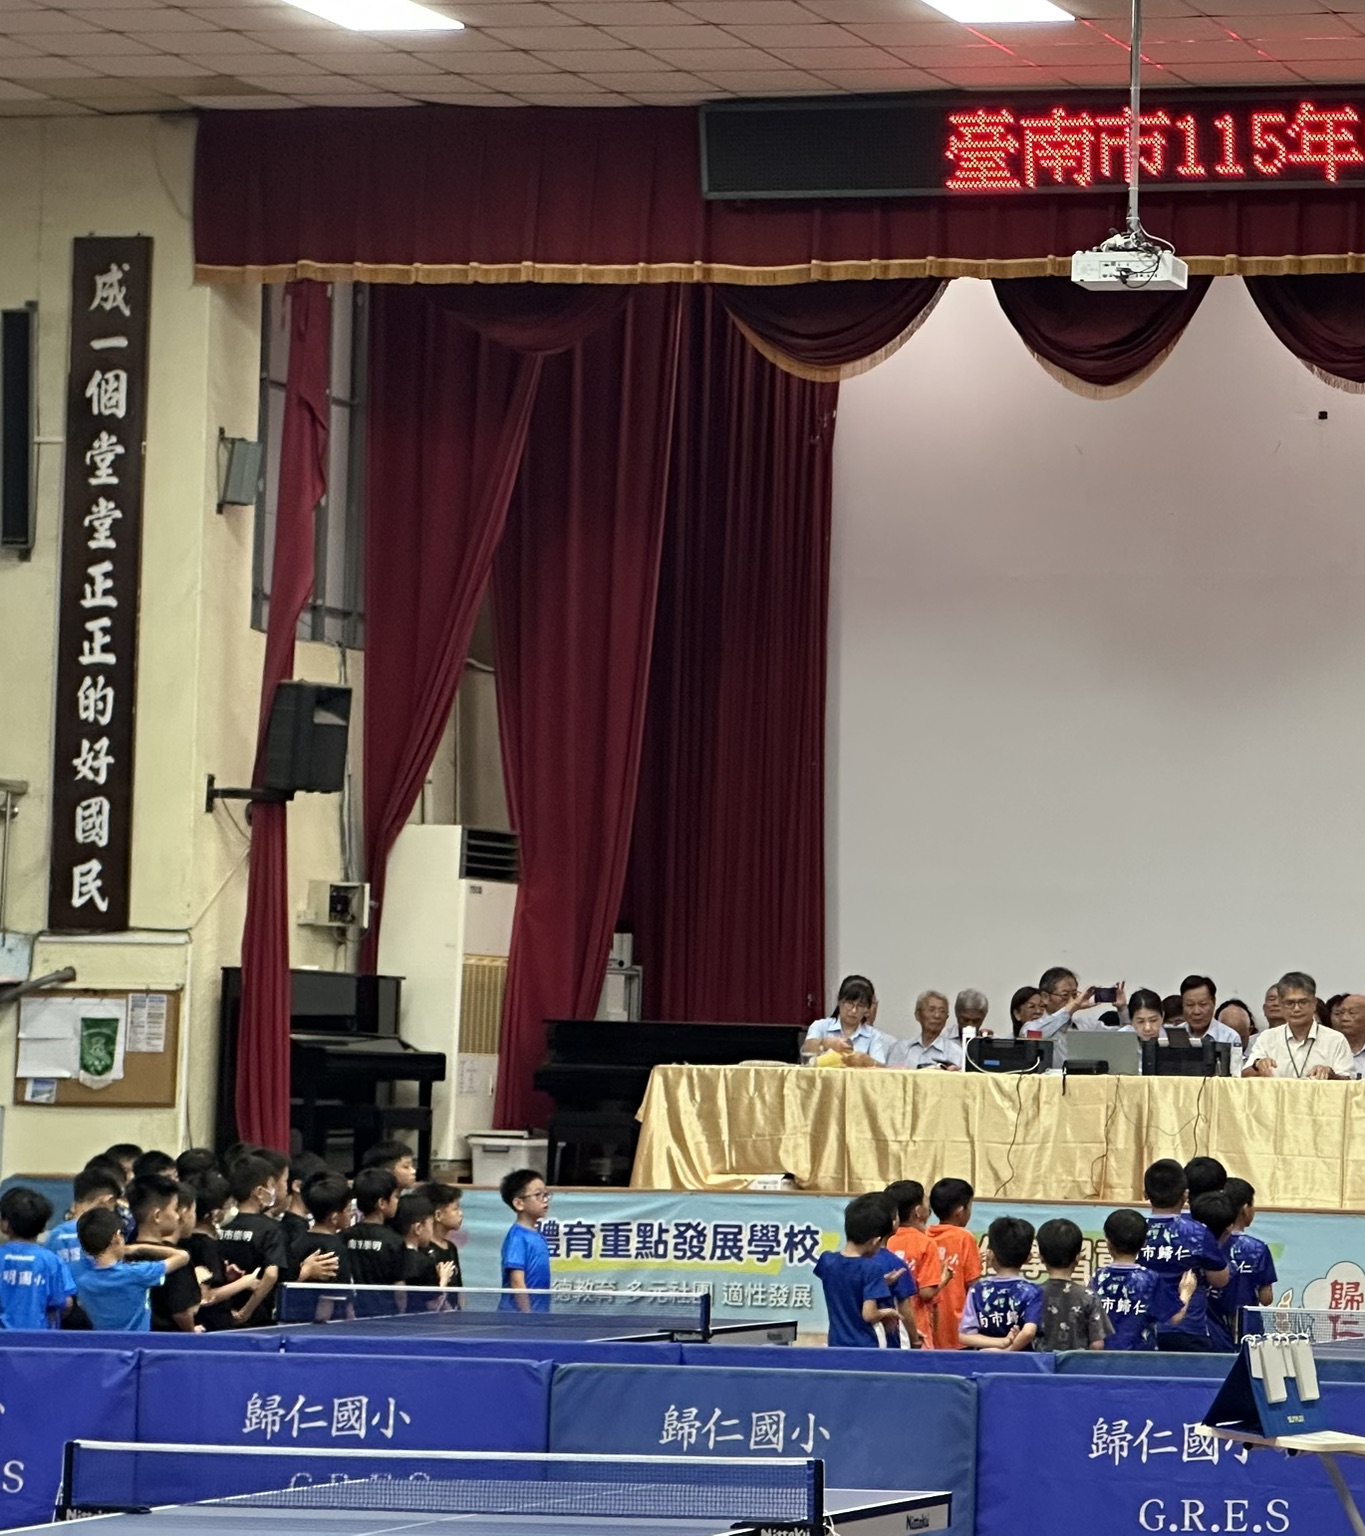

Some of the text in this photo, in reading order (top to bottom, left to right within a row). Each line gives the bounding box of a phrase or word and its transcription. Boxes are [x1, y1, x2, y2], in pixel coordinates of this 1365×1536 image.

[71, 262, 131, 912] 成一個堂堂正正的好國民
[536, 1220, 820, 1264] 體育重點發展學校
[1136, 1245, 1192, 1262] 市歸仁
[722, 1280, 813, 1309] 適性發展
[242, 1392, 412, 1440] 歸仁國小
[658, 1404, 832, 1453] 歸仁國小
[1138, 1498, 1291, 1534] G.R.E.S
